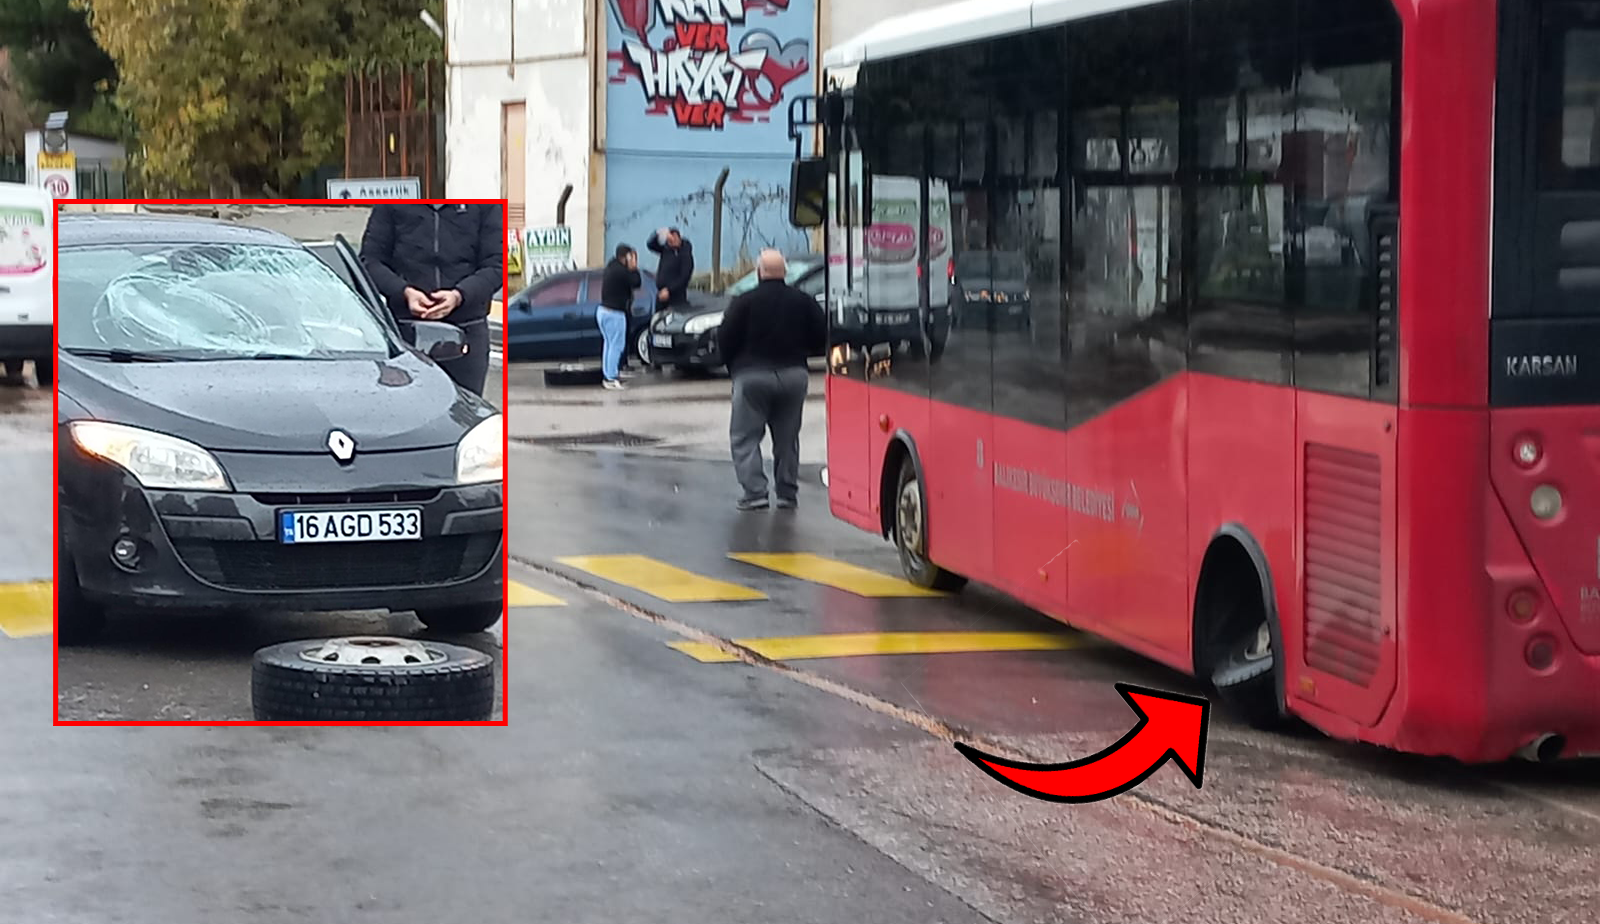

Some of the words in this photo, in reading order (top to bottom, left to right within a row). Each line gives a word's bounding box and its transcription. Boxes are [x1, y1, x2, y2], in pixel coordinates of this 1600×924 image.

[676, 22, 728, 50] VER
[624, 40, 768, 108] HAYAT
[674, 101, 725, 127] VER
[1506, 354, 1578, 376] KARSAN
[296, 515, 319, 539] 16
[324, 514, 372, 538] AGD
[379, 512, 418, 537] 533
